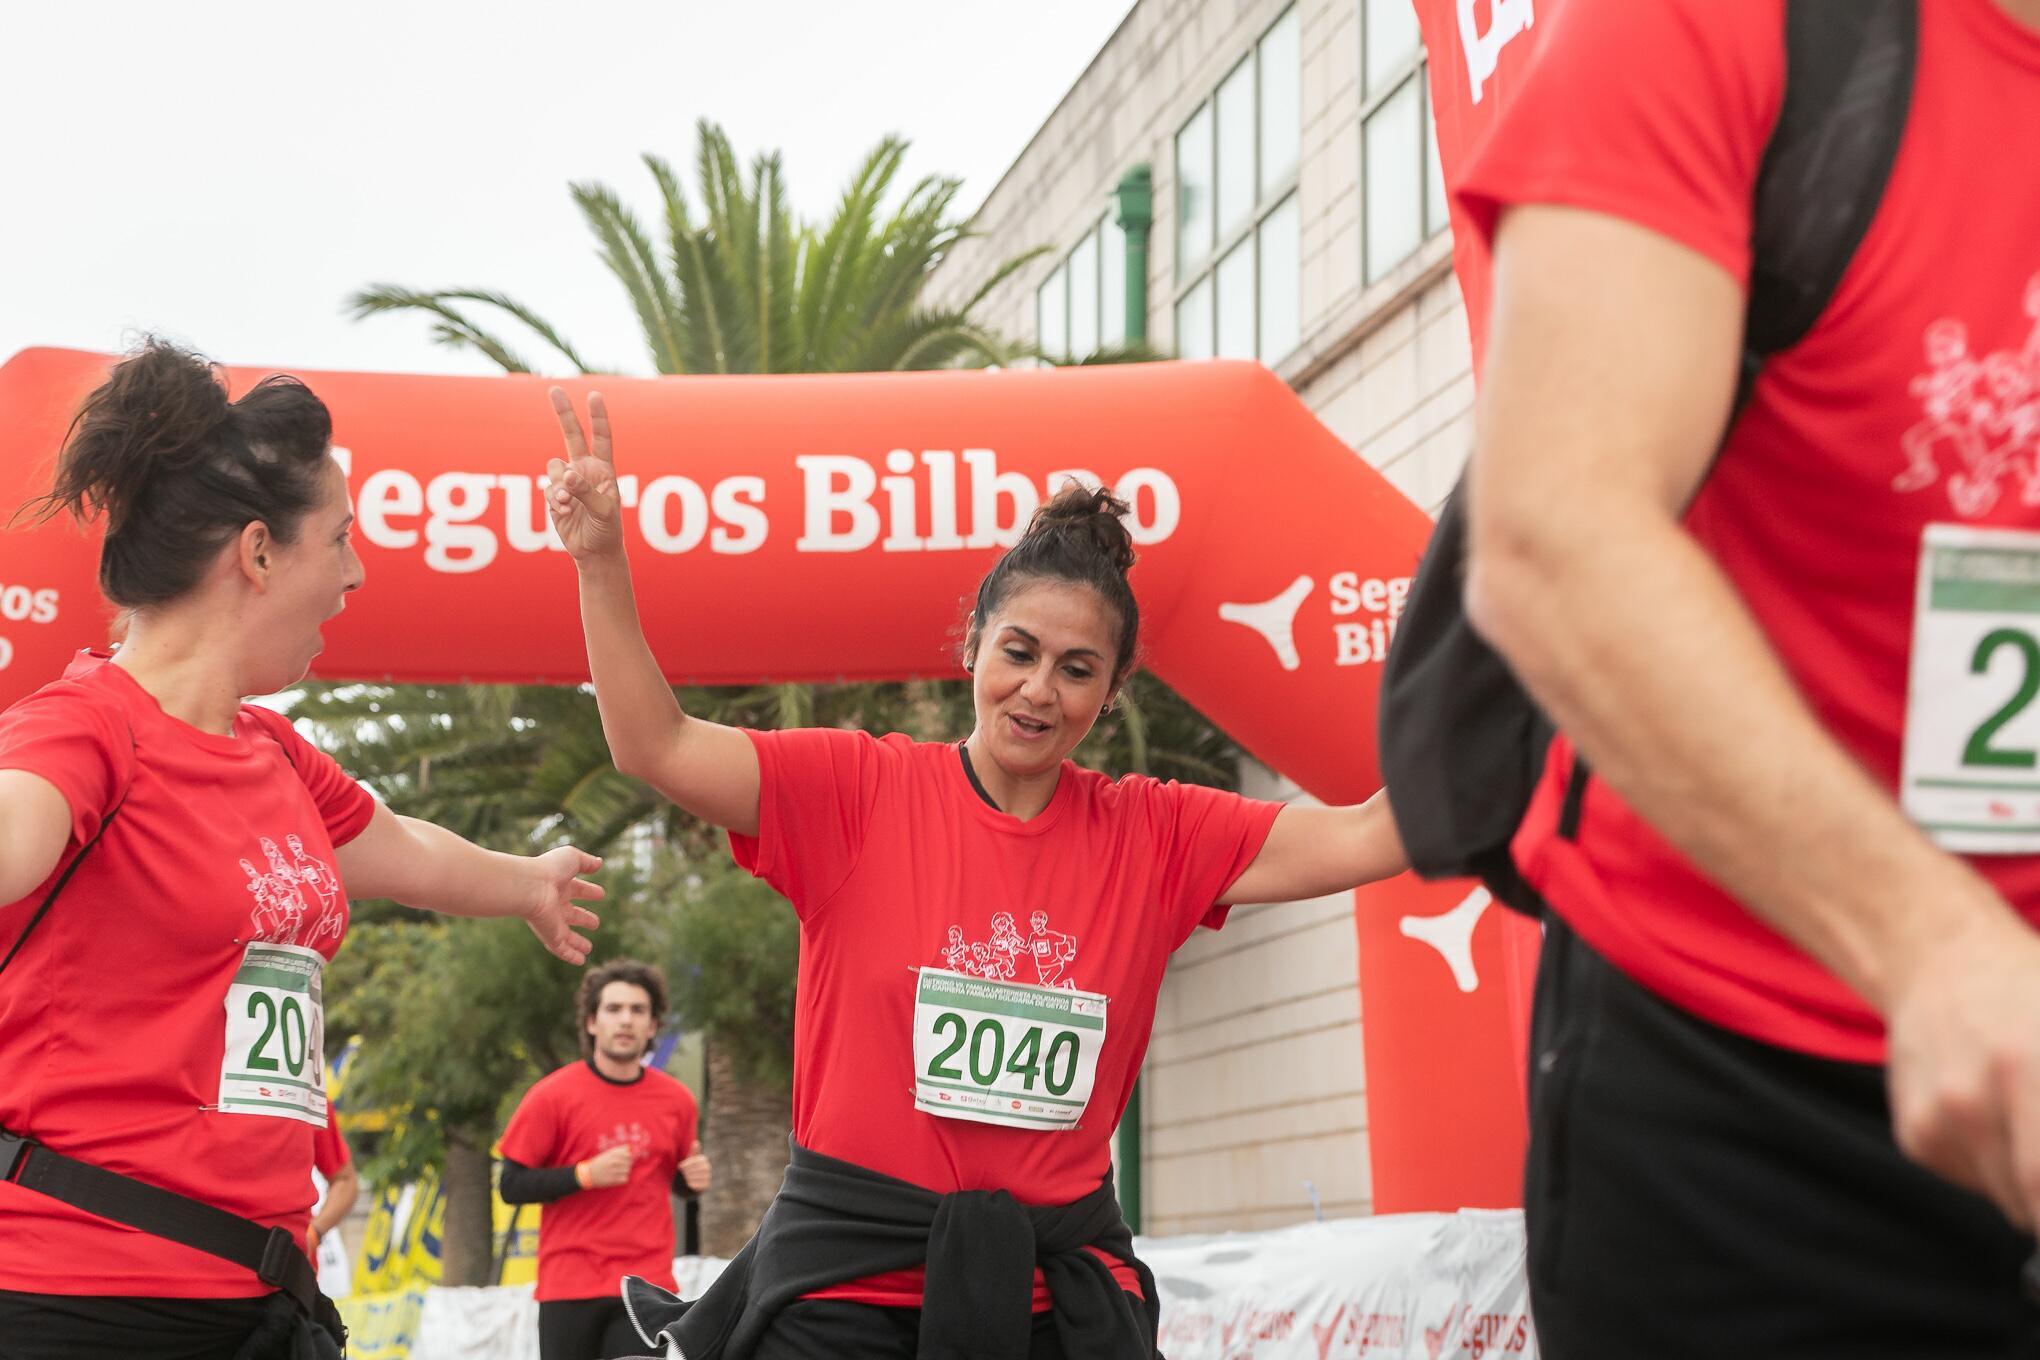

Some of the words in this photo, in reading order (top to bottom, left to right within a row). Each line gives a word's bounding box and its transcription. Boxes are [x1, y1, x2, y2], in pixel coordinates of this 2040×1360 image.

[329, 446, 769, 574] eguos
[796, 448, 1181, 553] Bilbo
[1961, 627, 2040, 768] 2
[928, 1012, 1080, 1097] 2040
